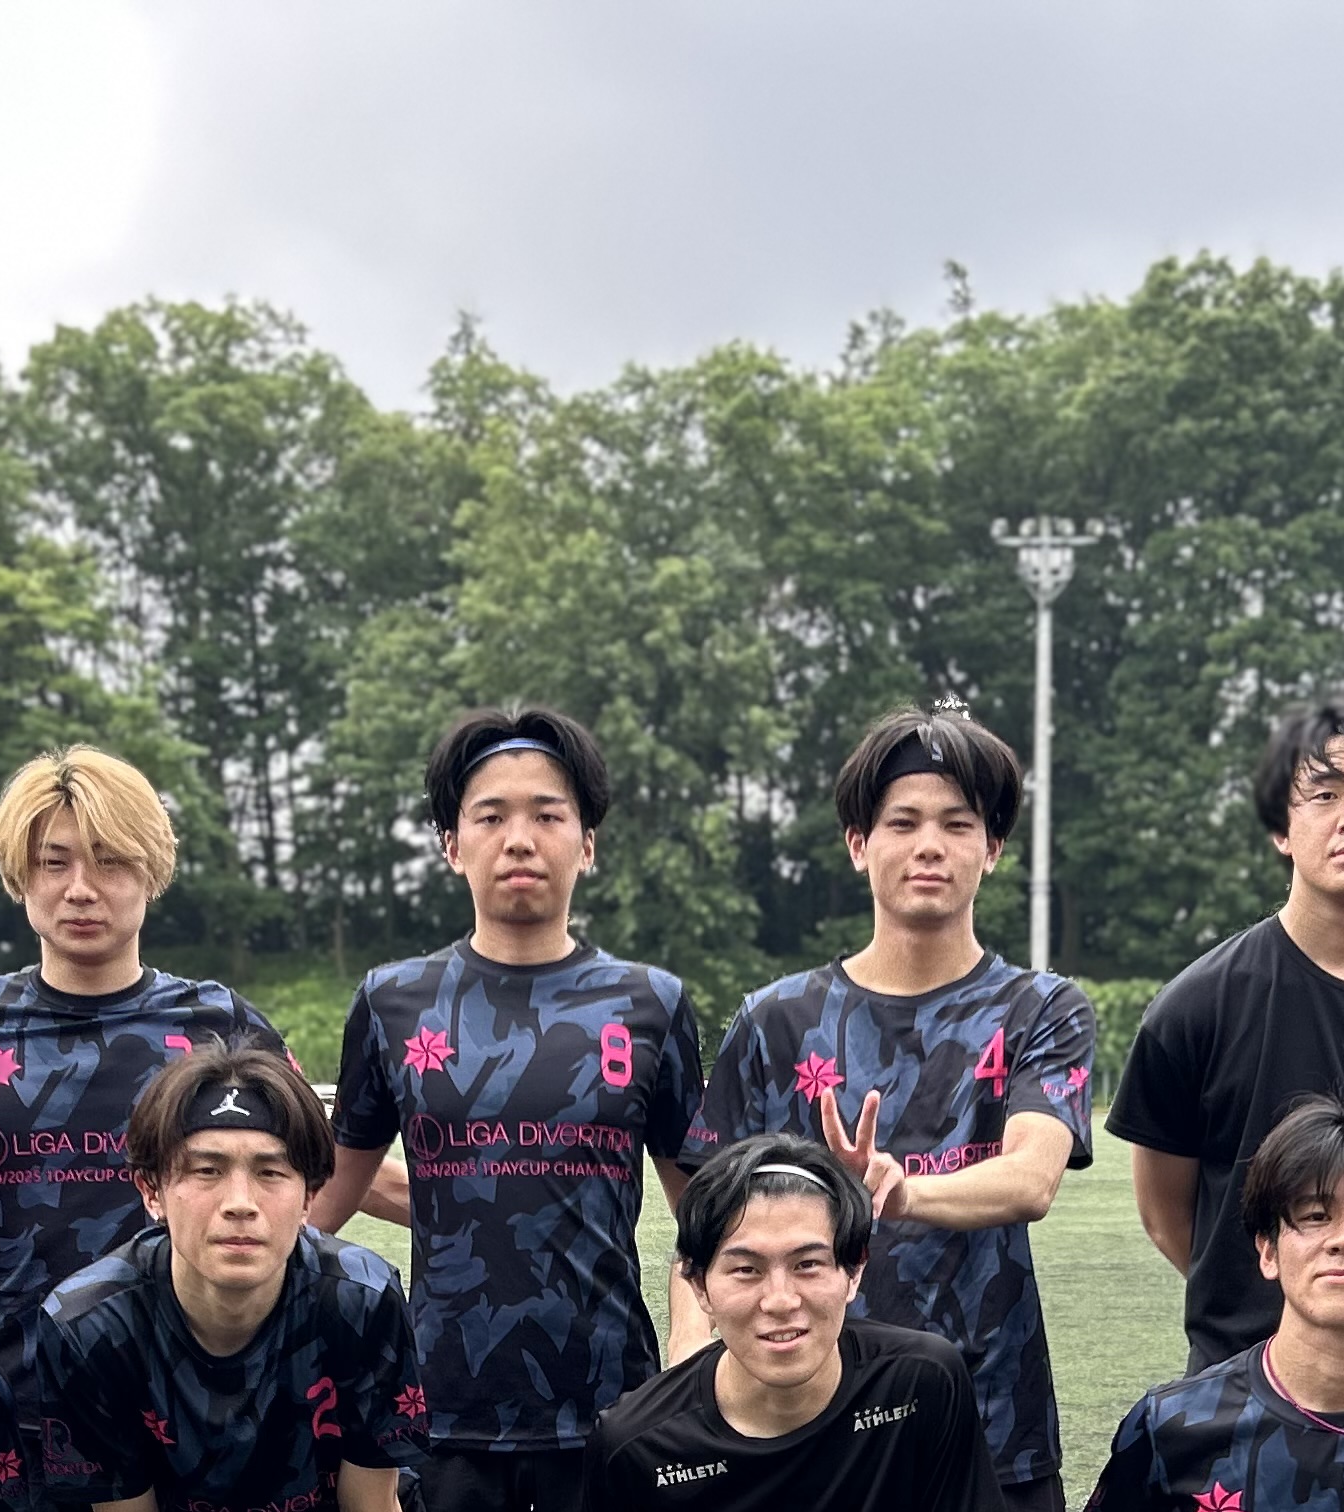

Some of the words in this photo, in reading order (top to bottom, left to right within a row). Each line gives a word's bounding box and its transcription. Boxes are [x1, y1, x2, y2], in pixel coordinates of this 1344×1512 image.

[600, 1022, 633, 1088] 8
[974, 1026, 1009, 1098] 4
[13, 1132, 76, 1156] LiGA
[448, 1121, 511, 1147] LiGA
[306, 1376, 342, 1440] 2
[853, 1404, 913, 1432] ATHLETA
[657, 1461, 728, 1487] ATHLETA
